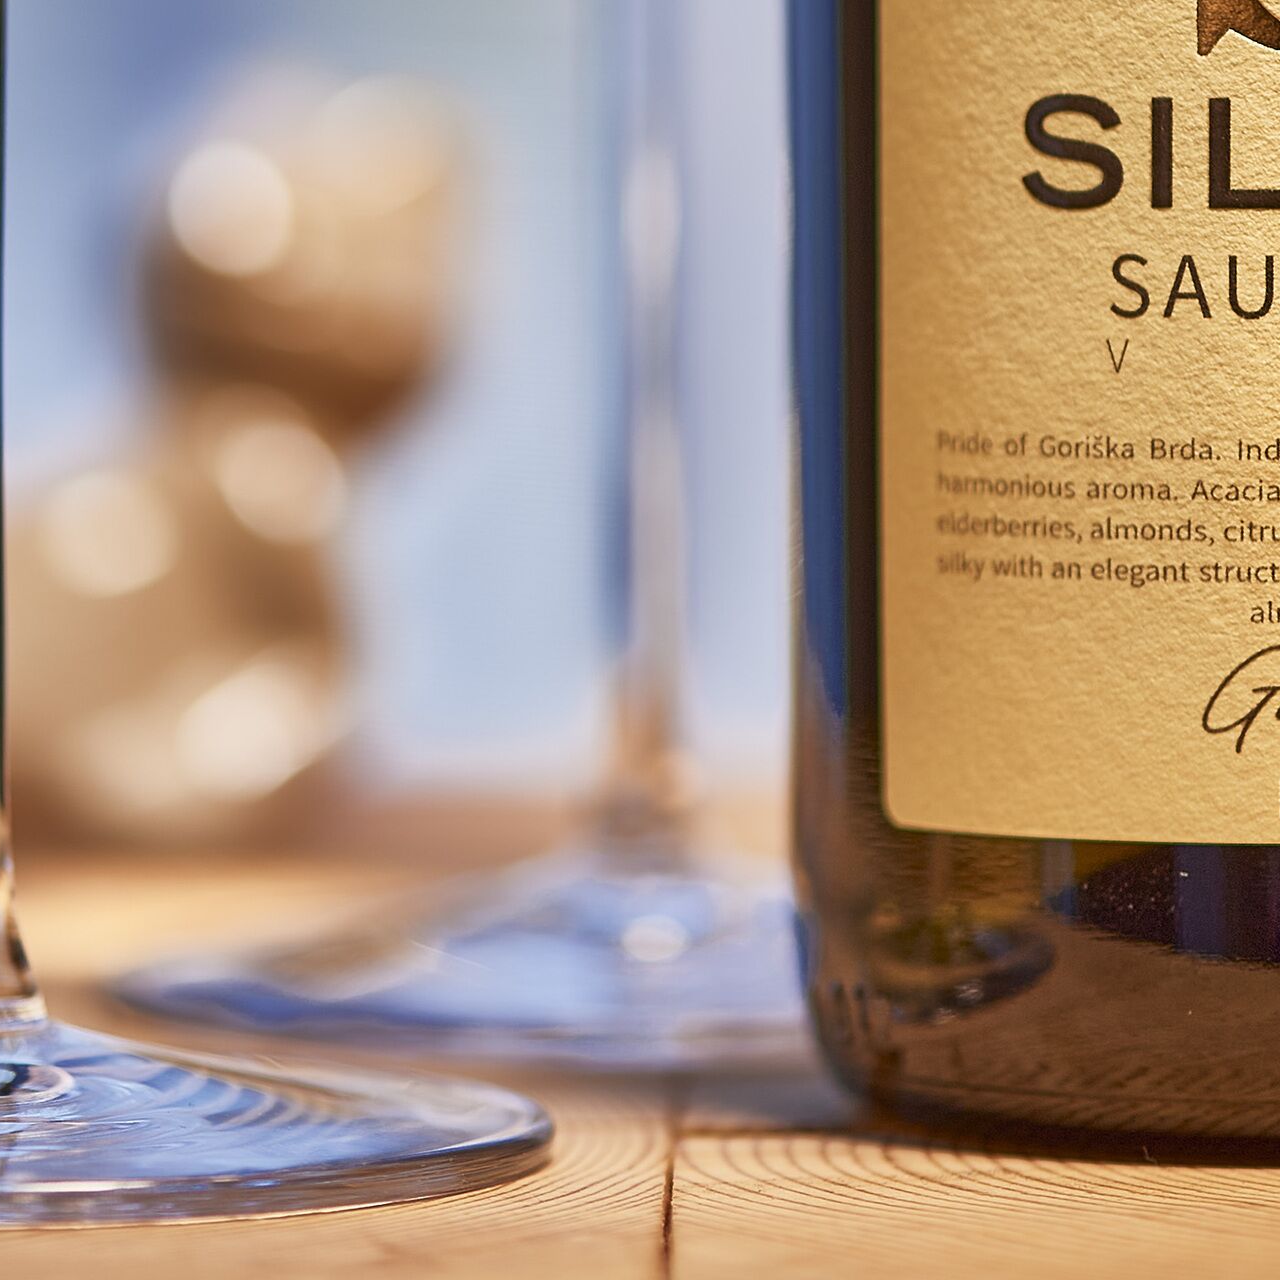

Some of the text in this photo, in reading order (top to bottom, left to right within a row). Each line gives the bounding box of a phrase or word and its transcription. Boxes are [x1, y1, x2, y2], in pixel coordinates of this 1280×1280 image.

[937, 432, 993, 453] Pride
[1004, 432, 1029, 456] of
[1040, 434, 1135, 459] Goriška
[1150, 438, 1221, 461] Brda.
[937, 471, 1075, 500] harmonious
[1086, 481, 1179, 501] aroma.
[1191, 480, 1280, 502] Acacia
[937, 514, 1083, 544] elderberries,
[1090, 518, 1214, 546] almonds,
[937, 553, 984, 580] silky
[992, 554, 1042, 578] with
[1051, 562, 1082, 579] an
[1090, 558, 1189, 587] elegant
